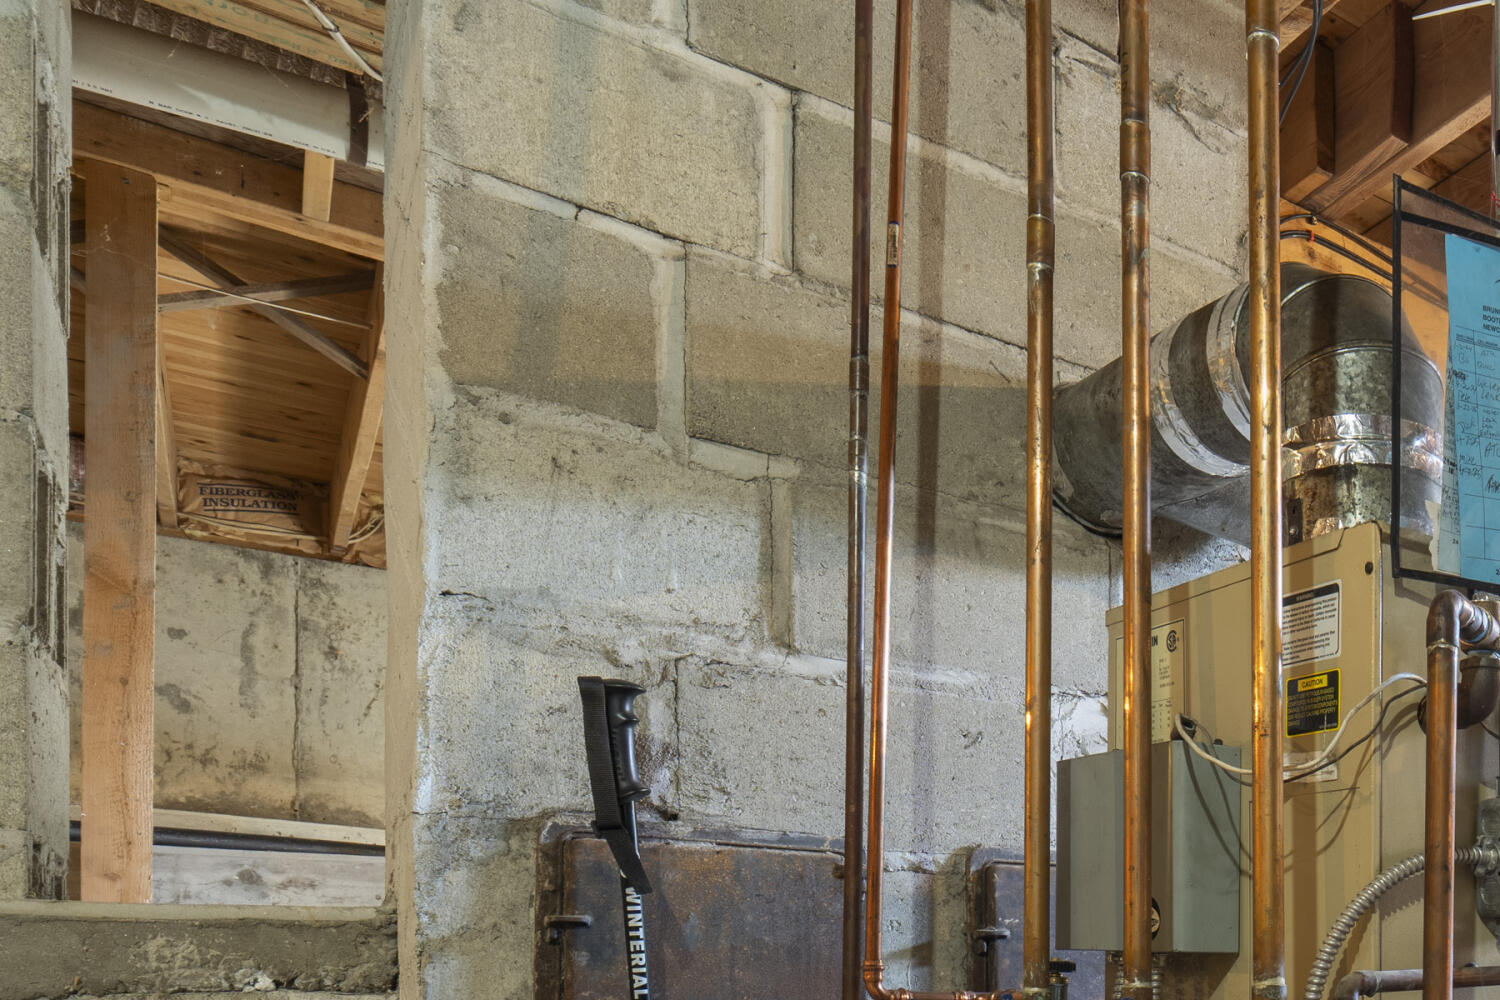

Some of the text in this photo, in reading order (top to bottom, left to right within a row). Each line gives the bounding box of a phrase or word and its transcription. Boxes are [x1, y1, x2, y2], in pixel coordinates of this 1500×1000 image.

[203, 498, 297, 511] INSULATION
[1302, 678, 1324, 689] CAUTION
[625, 886, 649, 1000] WINTERIAL
